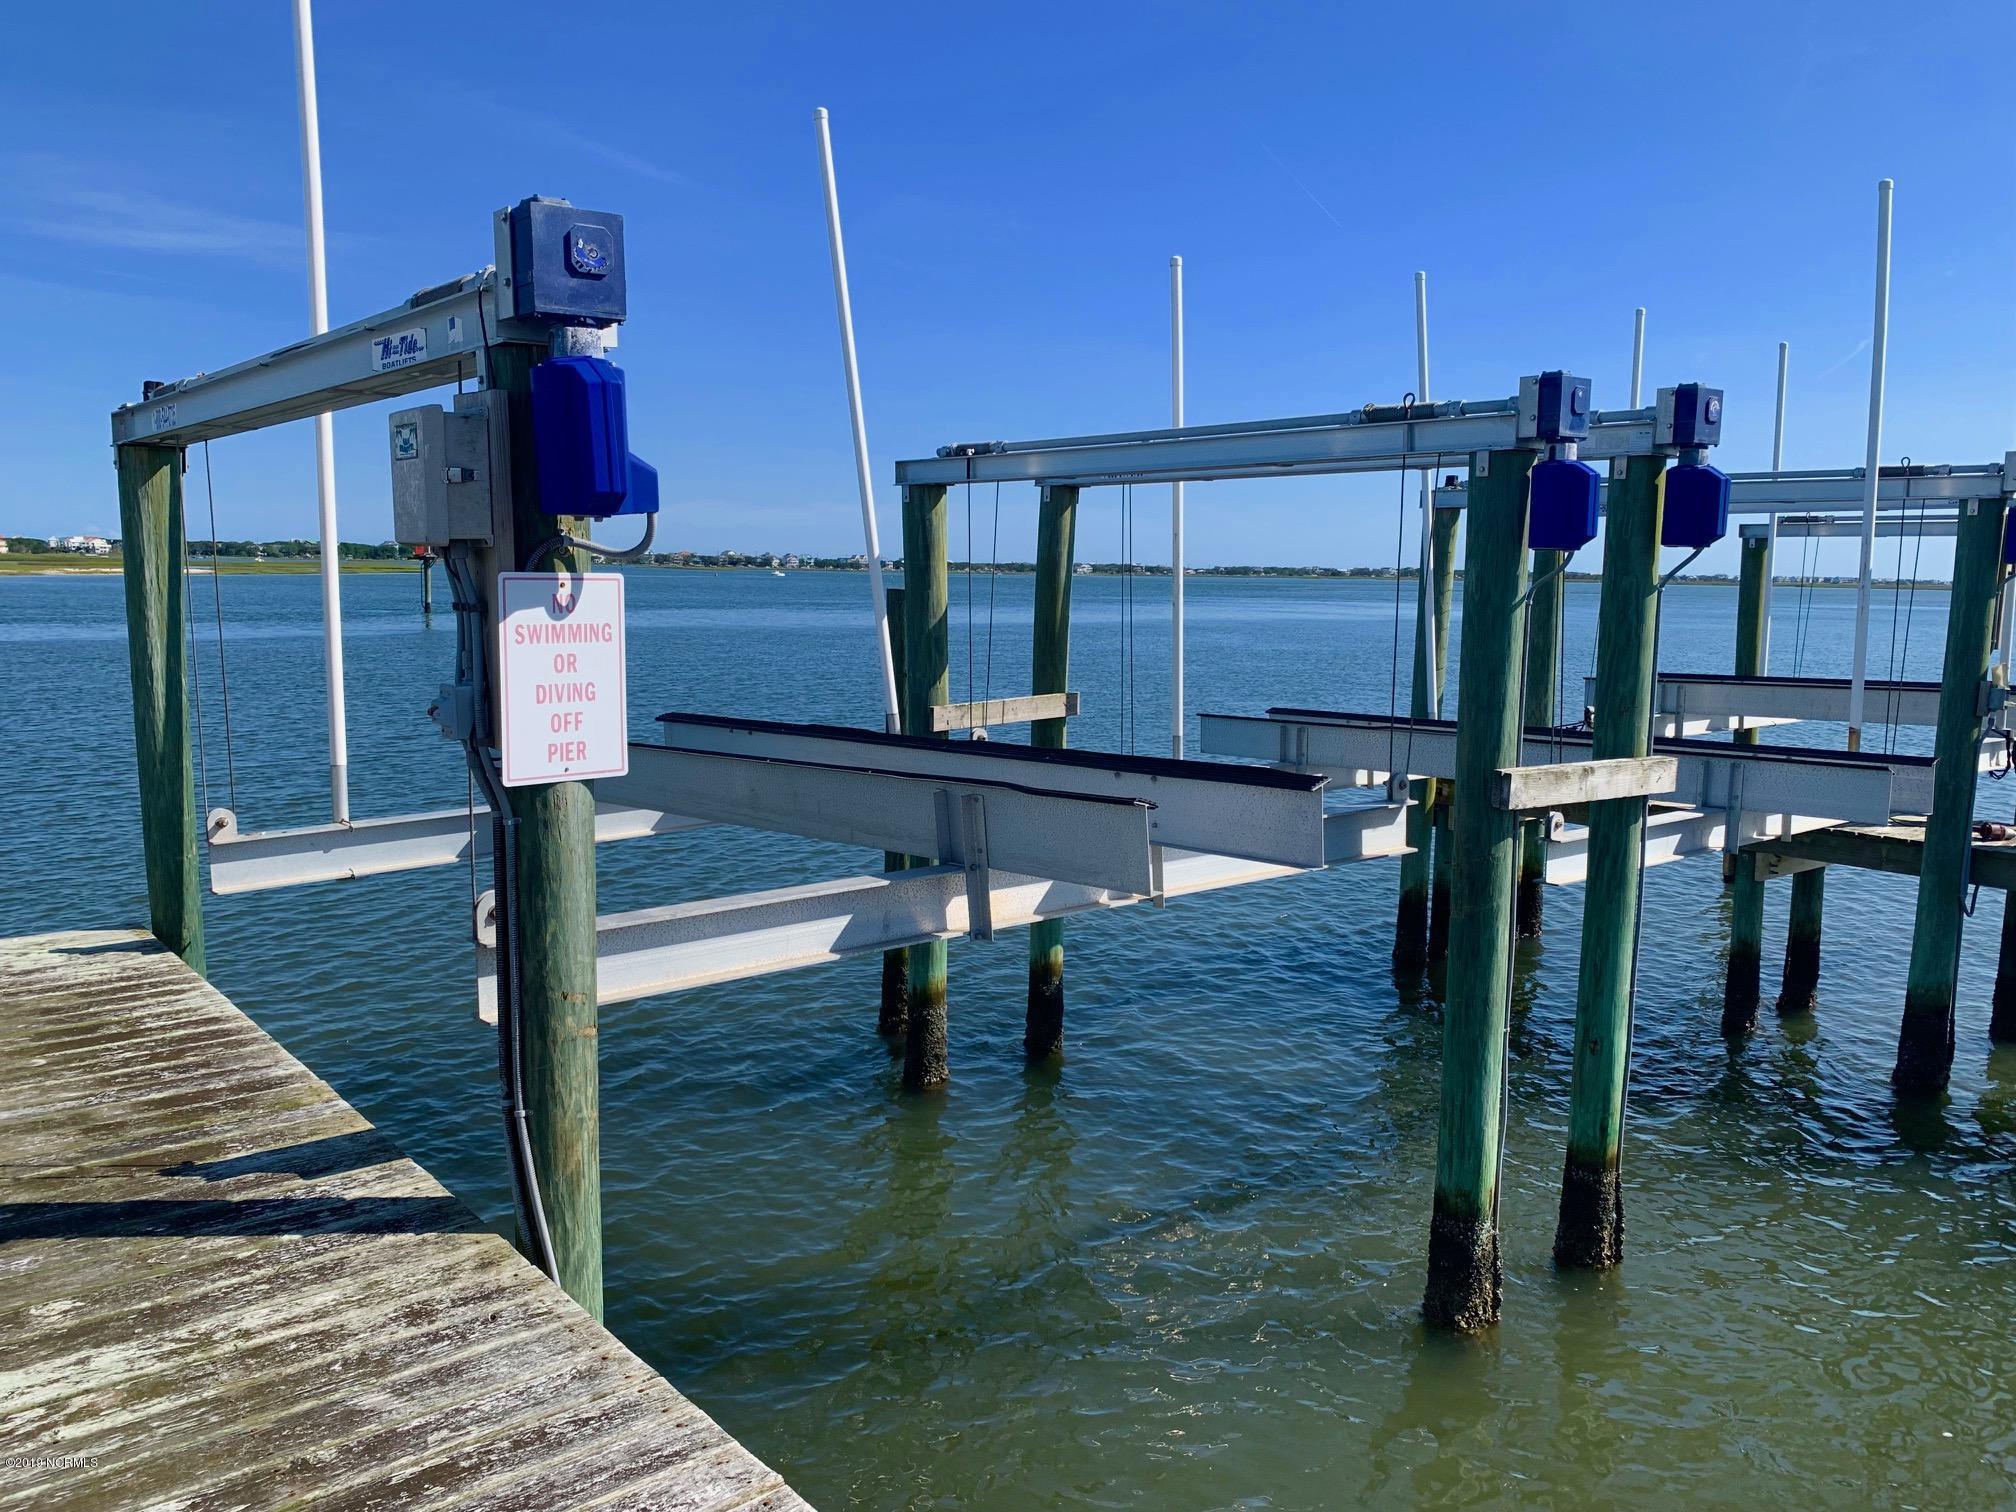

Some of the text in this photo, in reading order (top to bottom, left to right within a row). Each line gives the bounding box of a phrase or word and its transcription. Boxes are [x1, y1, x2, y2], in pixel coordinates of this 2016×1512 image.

[382, 356, 417, 370] BOATLIFTS
[552, 593, 576, 614] NO
[515, 622, 613, 645] SWIMMING
[553, 653, 578, 674] OR
[536, 681, 596, 705] DIVING
[550, 711, 583, 733] OFF
[547, 740, 587, 763] PIER
